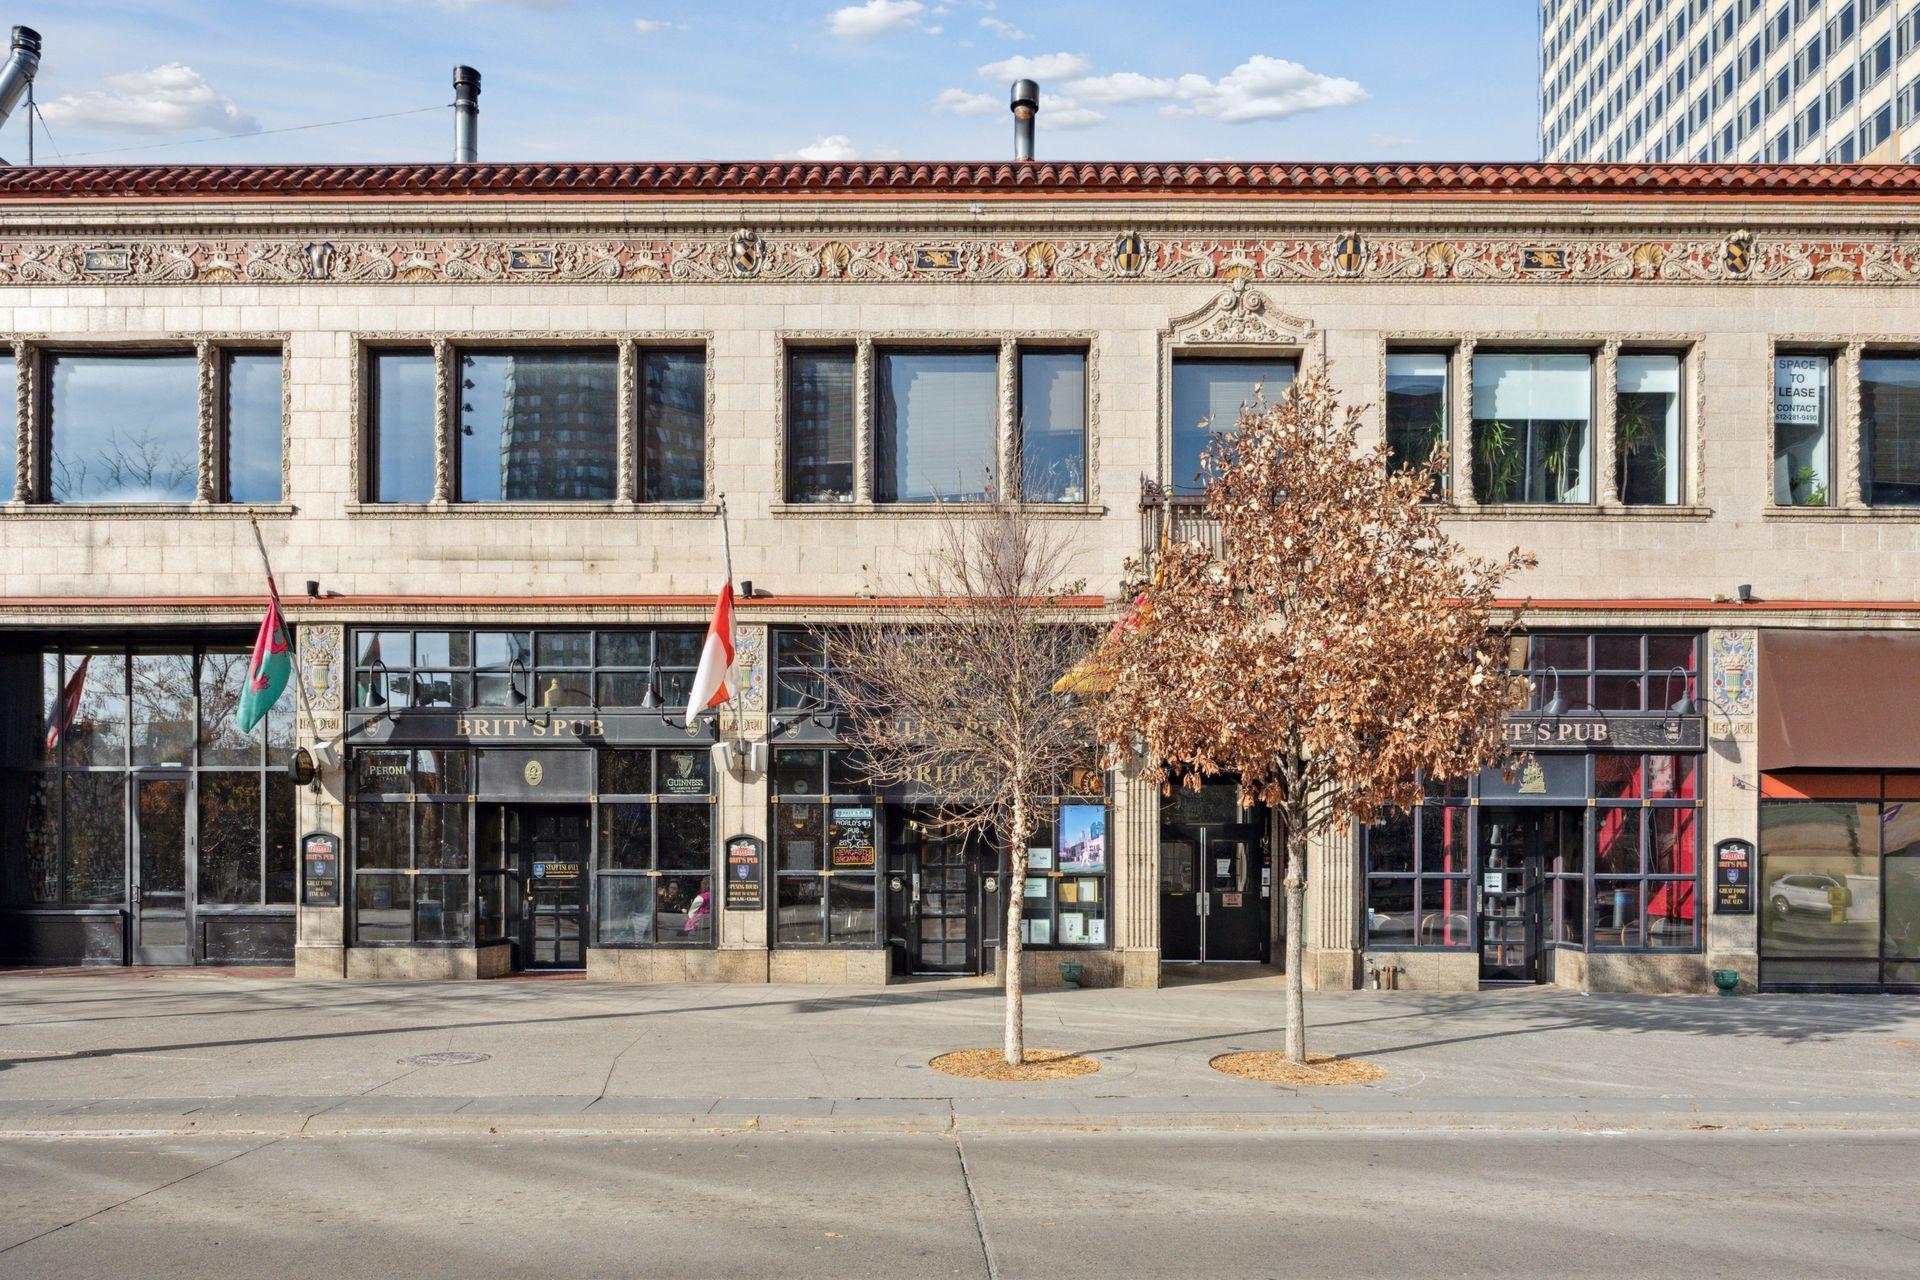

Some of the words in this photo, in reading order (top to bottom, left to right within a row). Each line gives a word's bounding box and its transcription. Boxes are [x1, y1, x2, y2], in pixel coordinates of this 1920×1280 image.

[1779, 360, 1816, 370] SPACE
[1790, 374, 1805, 383] TO
[1779, 387, 1815, 397] LEASE
[1776, 404, 1817, 412] CONTACT
[456, 719, 546, 736] BRIT'S
[552, 719, 604, 736] PUB
[1557, 723, 1608, 741] PUB
[370, 765, 406, 775] PERONI
[667, 779, 703, 787] GUINNESS
[835, 855, 858, 863] BROWN
[861, 854, 871, 863] ALE
